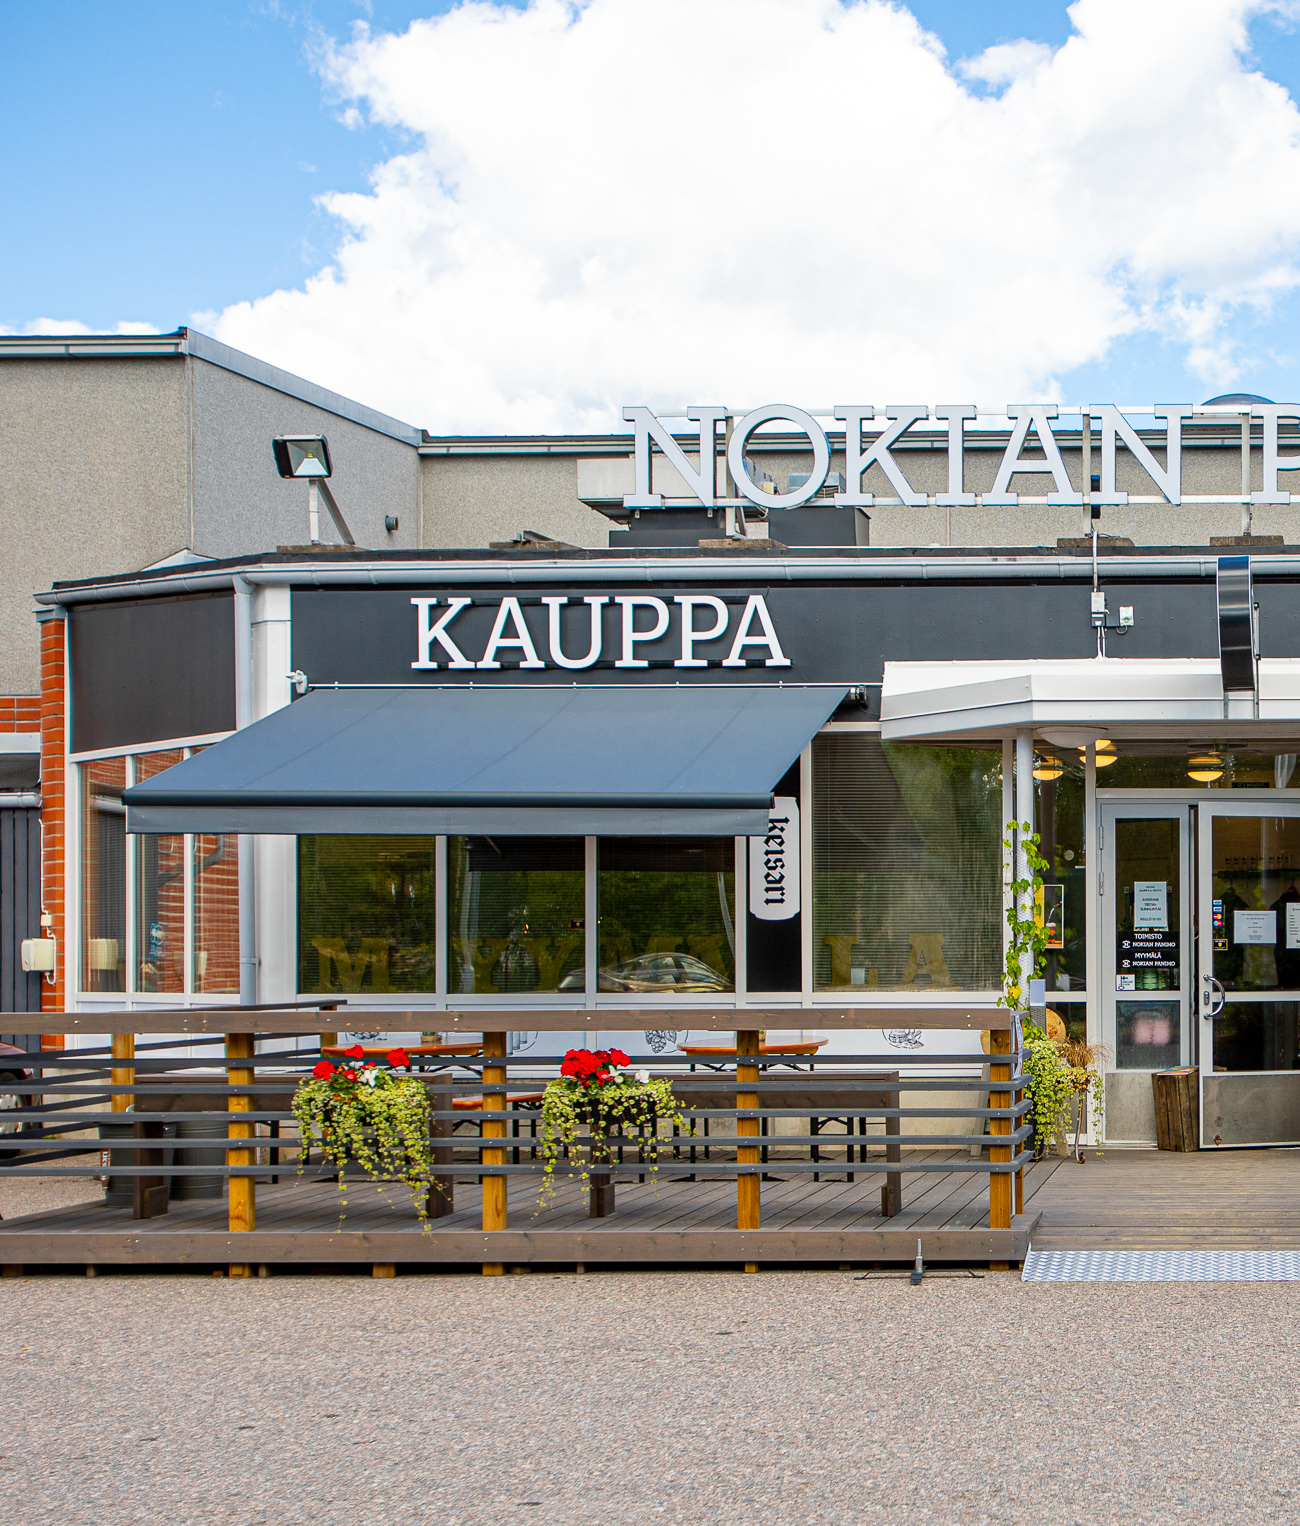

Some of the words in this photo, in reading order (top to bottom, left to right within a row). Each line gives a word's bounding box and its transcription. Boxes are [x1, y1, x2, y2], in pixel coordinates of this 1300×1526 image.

[622, 404, 1194, 509] NOKIAN
[410, 594, 793, 671] KAUPPA
[763, 816, 790, 906] keisari
[1134, 951, 1162, 959] MYYMÄLÄ
